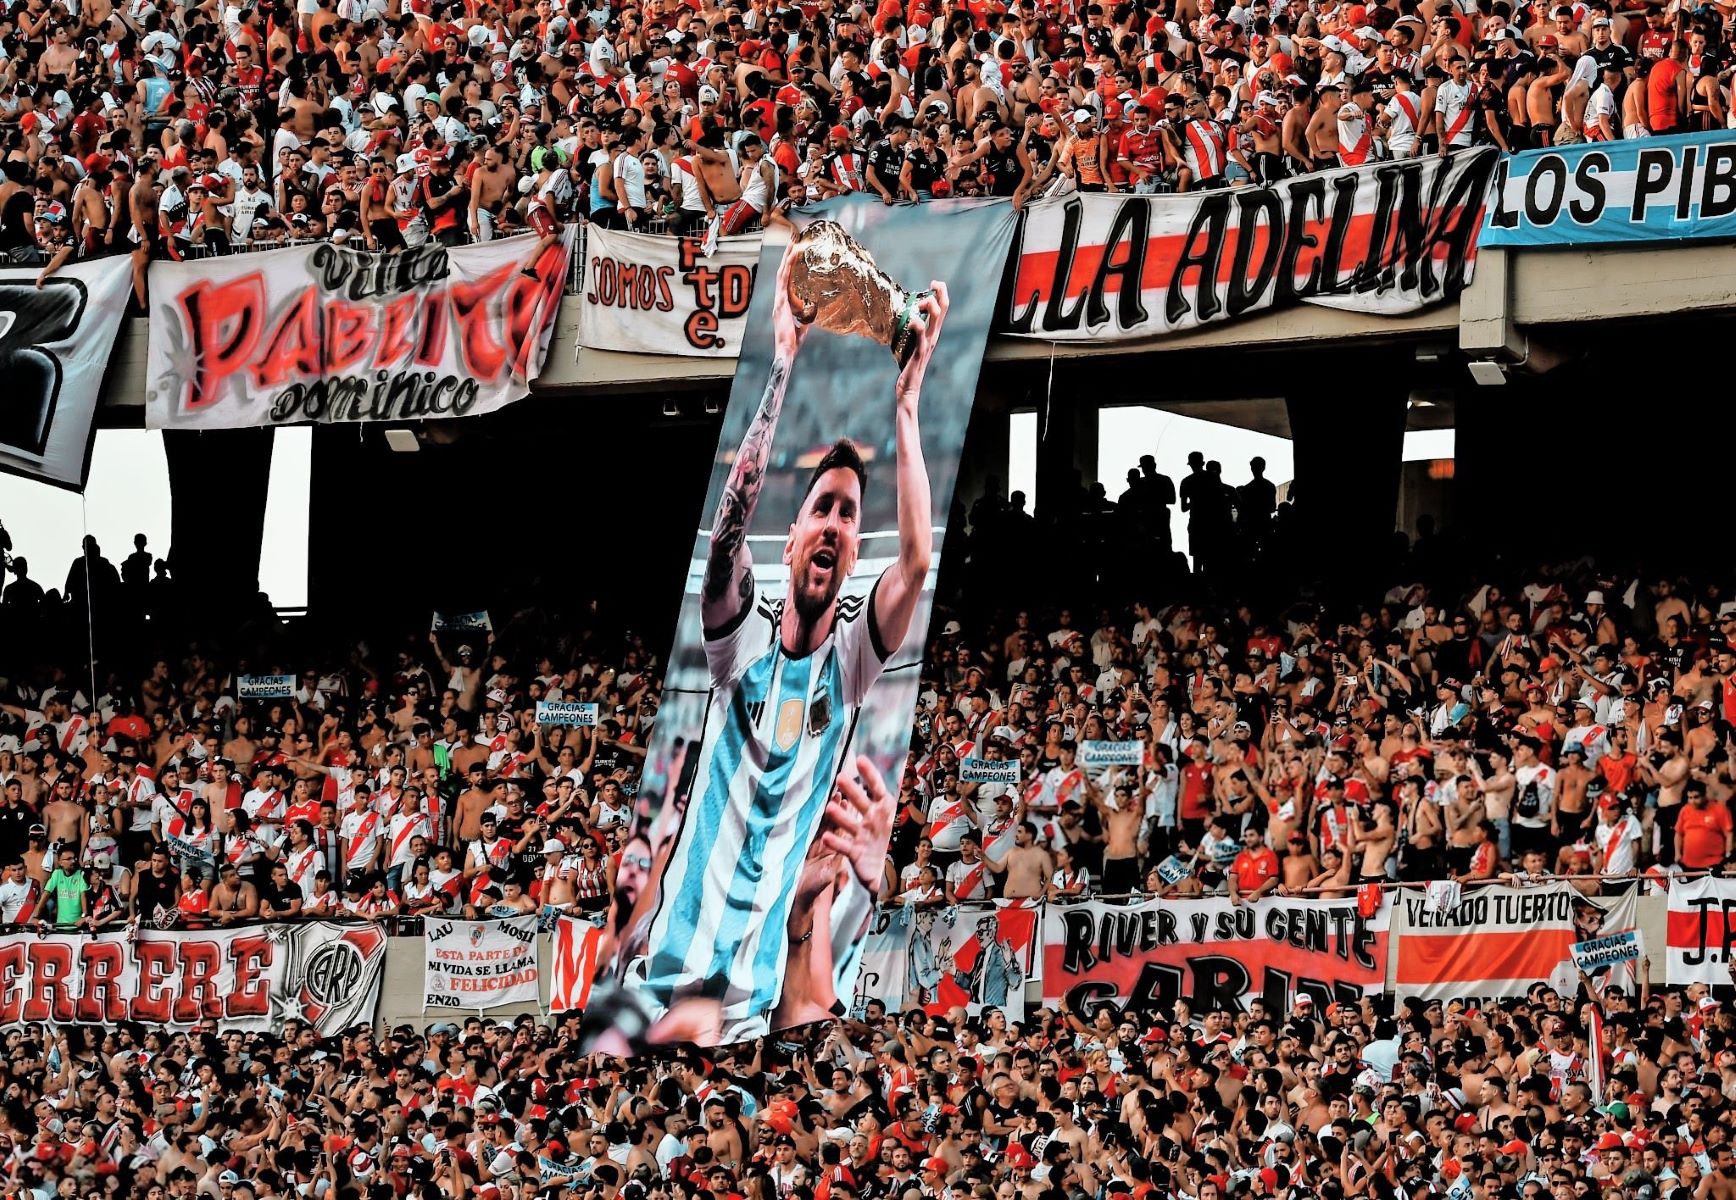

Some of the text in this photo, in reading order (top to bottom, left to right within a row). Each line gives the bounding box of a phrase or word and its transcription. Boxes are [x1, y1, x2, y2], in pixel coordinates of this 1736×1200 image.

[1489, 152, 1612, 229] LOS
[1166, 150, 1498, 325] ADELINA
[587, 255, 675, 312] SOMOS
[248, 675, 284, 686] GRACIAS
[240, 686, 292, 697] CAMPEONES
[547, 702, 586, 712] GRACIAS
[538, 713, 594, 724] CAMPEONES
[971, 759, 1010, 770] GRACIAS
[962, 770, 1016, 781] CAMPEONES
[1406, 891, 1571, 928] VENADO TUERTO
[427, 922, 454, 942] LAU
[1062, 908, 1179, 975] RIVER
[1213, 907, 1256, 943] SU
[1265, 907, 1377, 970] GENTE
[435, 947, 465, 961] ESTA
[468, 949, 510, 961] PARTE
[1582, 934, 1627, 954] GRACIAS
[428, 955, 536, 976] MI VIDA SE LLAMA
[1576, 944, 1640, 968] CAMPEONES
[449, 968, 538, 992] FELICIDAD
[546, 1160, 584, 1174] GRACIAS
